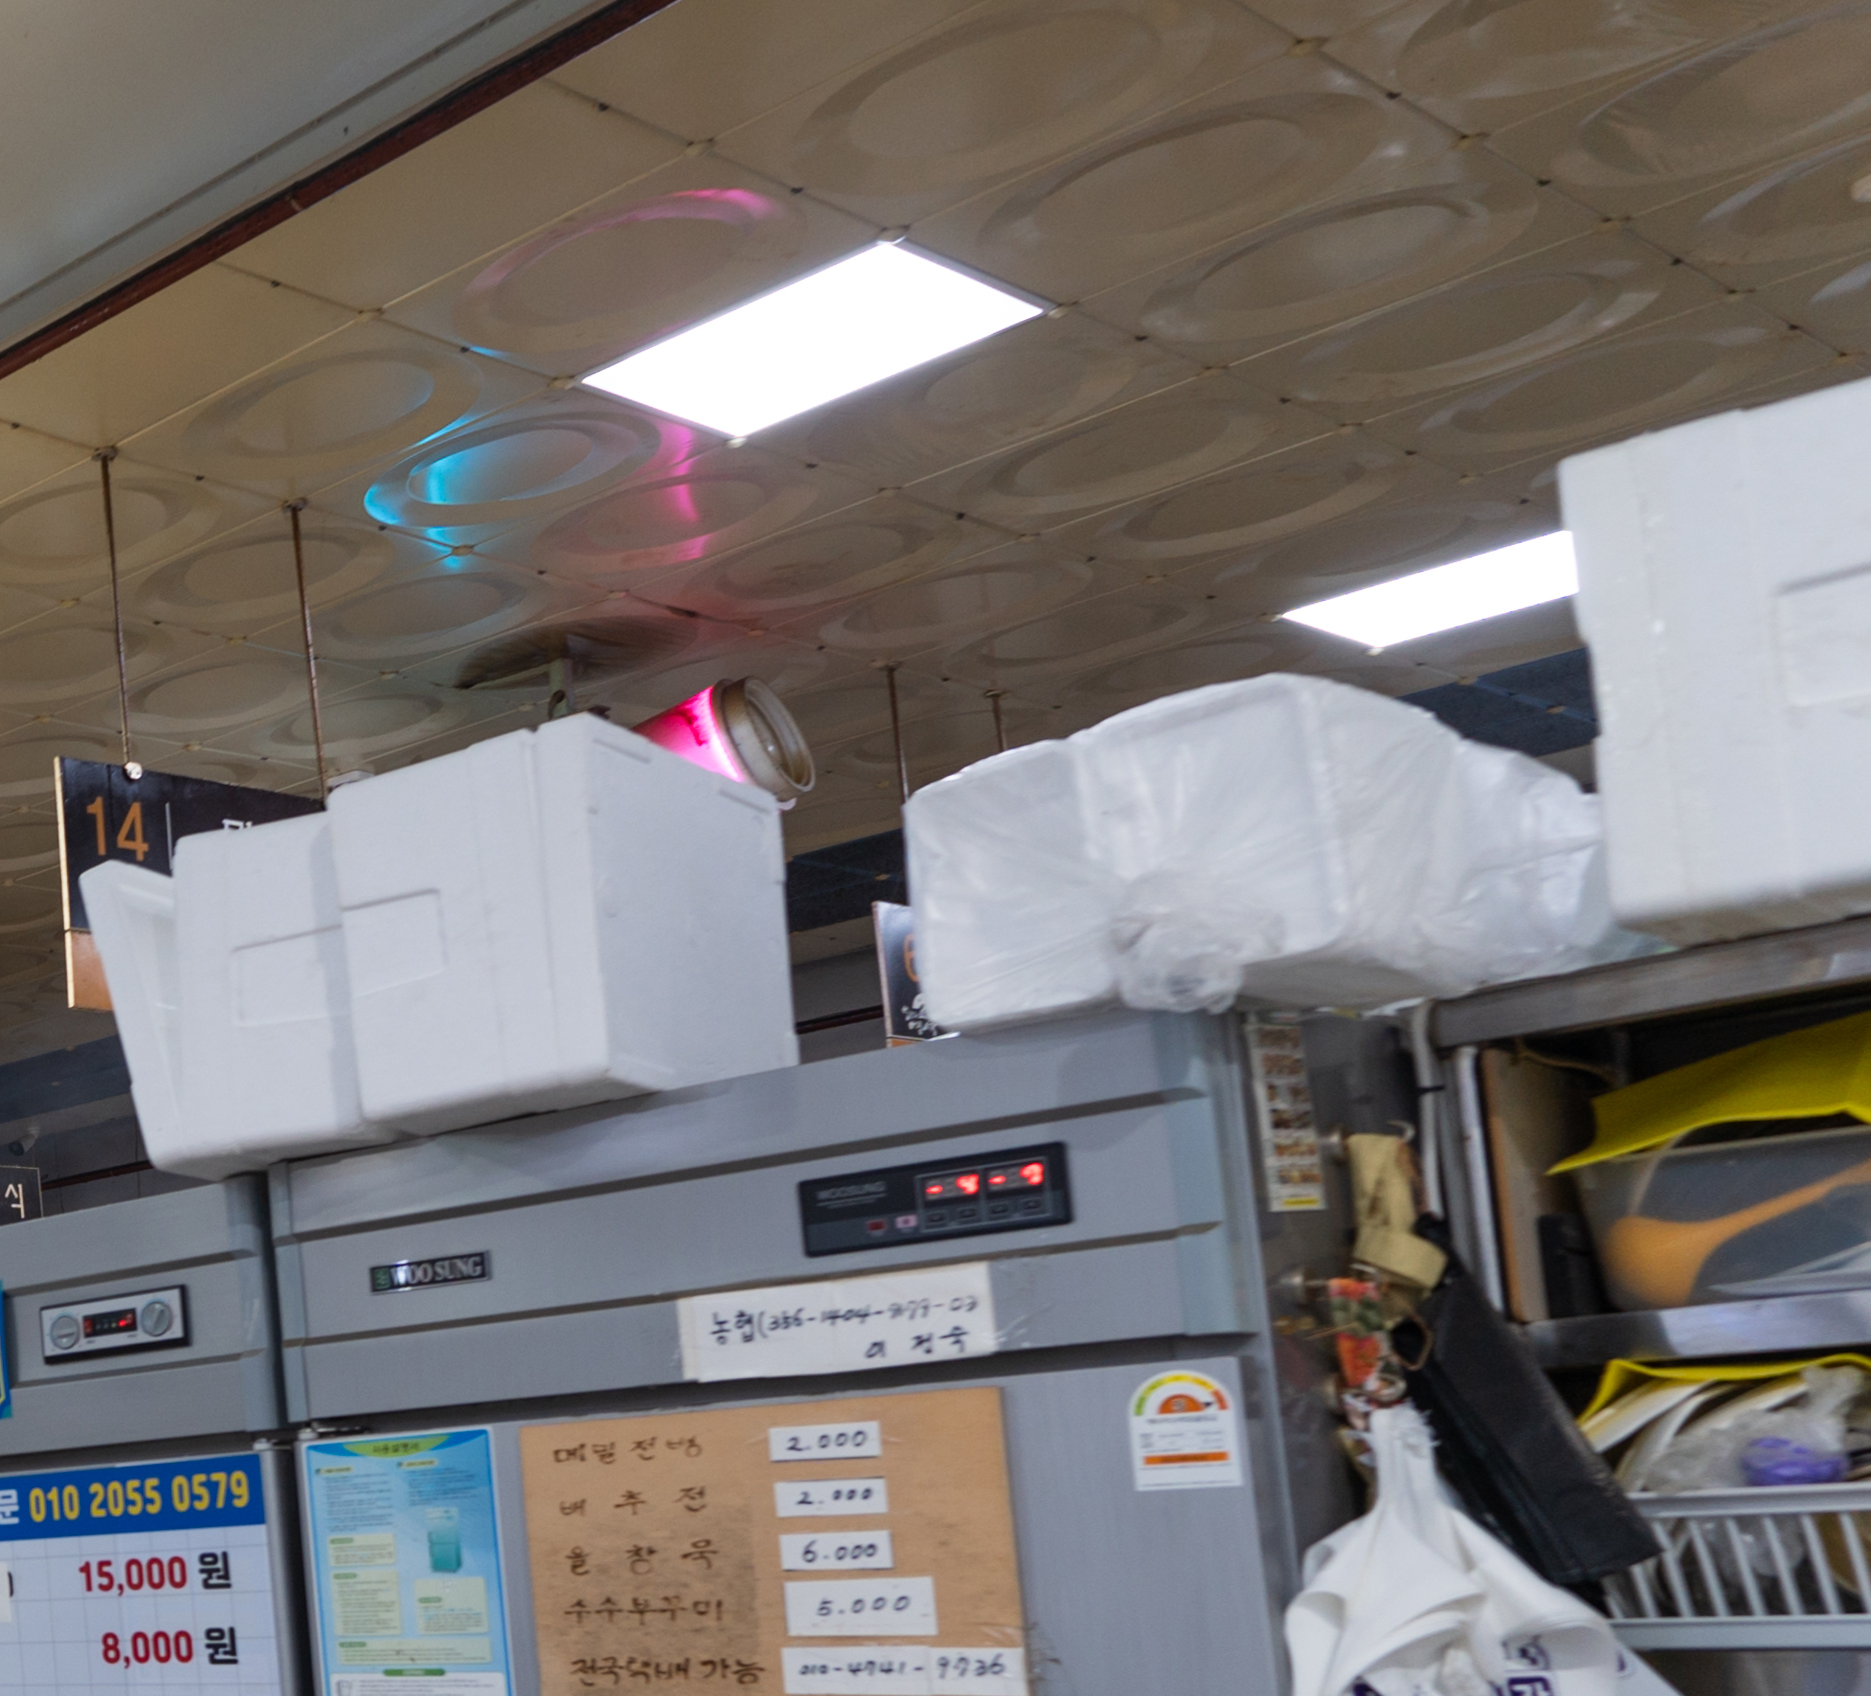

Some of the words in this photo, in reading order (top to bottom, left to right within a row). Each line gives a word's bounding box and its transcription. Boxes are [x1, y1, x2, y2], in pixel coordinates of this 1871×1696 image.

[85, 796, 150, 862] 14
[28, 1484, 80, 1523] 010
[89, 1477, 163, 1518] 2055
[171, 1470, 250, 1513] 0579
[78, 1556, 188, 1597] 15,000
[198, 1550, 233, 1590] 원
[100, 1629, 194, 1669] 8,000
[204, 1626, 239, 1666] 원
